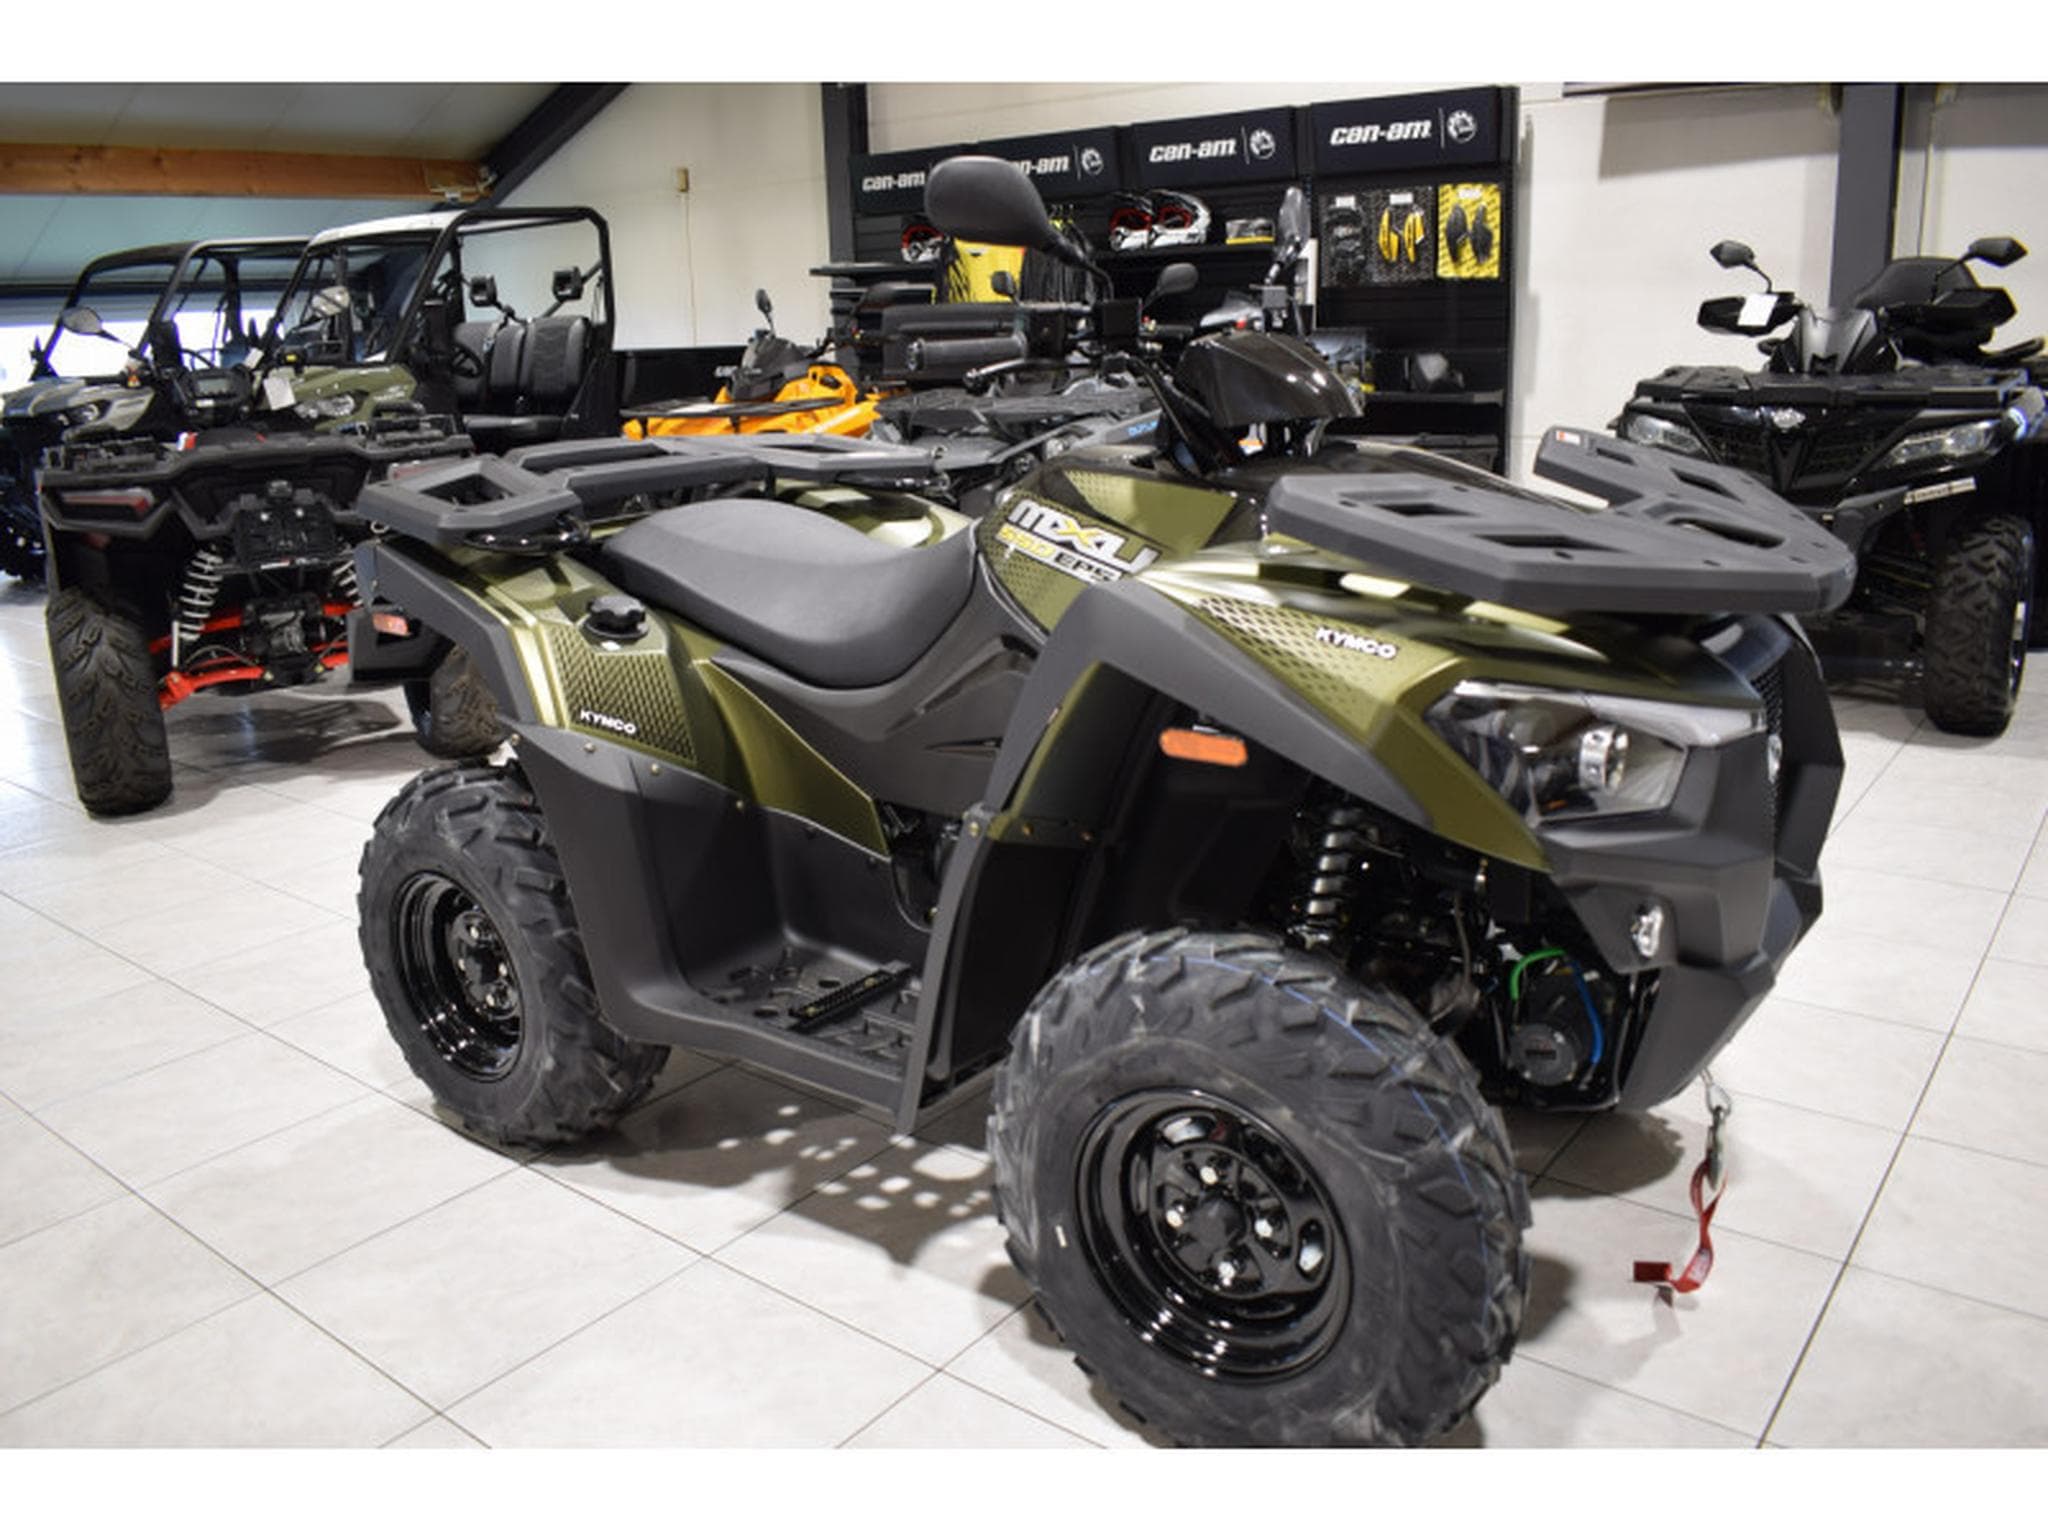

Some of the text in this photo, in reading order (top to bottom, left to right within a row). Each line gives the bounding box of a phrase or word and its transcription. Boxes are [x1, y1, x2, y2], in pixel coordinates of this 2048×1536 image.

[1329, 120, 1432, 146] can-am
[1149, 138, 1237, 163] can-am
[862, 171, 926, 192] can-am
[1055, 551, 1118, 583] EPS
[1315, 626, 1398, 660] KYMCO
[580, 709, 637, 735] KYMCO
